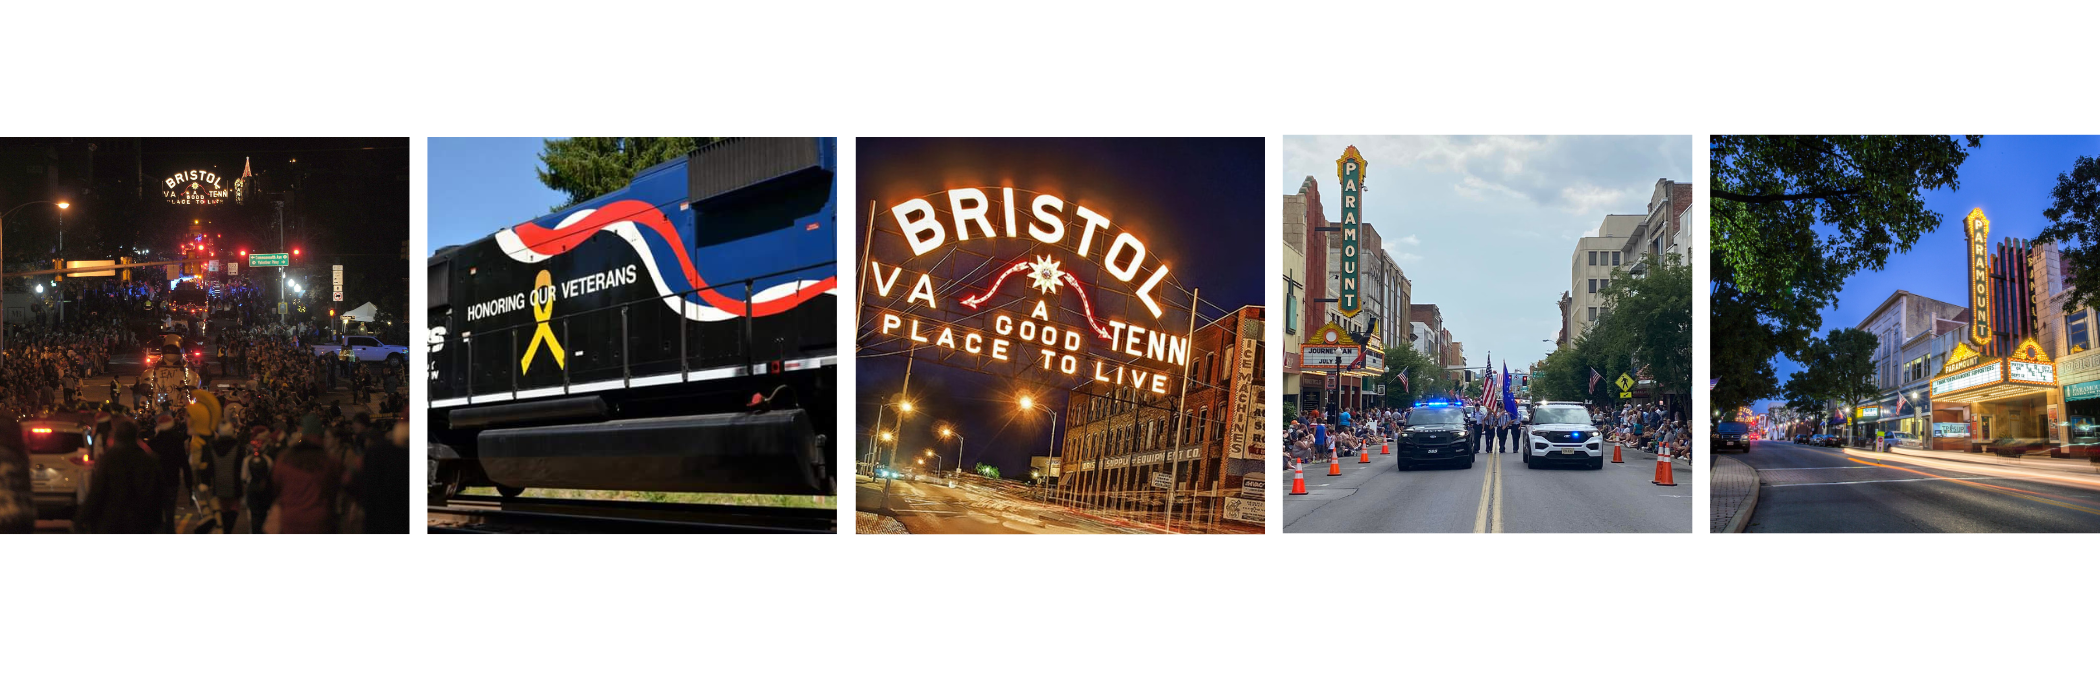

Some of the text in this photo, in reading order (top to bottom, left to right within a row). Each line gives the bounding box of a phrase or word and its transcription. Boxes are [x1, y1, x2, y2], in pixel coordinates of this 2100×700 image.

[165, 170, 221, 189] BRISTOL
[209, 190, 228, 198] TENN
[891, 187, 1169, 319] BRISTOL
[1344, 162, 1357, 307] PARAMOUNT
[467, 264, 637, 321] HONORING OUR VETERANS
[871, 261, 937, 309] VA
[1975, 219, 1986, 336] PARAMOUNT
[995, 315, 1080, 351] GOOD
[1031, 300, 1049, 321] A
[882, 313, 1167, 394] PLACE TO LIVE
[1109, 320, 1187, 366] TENN
[1945, 356, 1978, 374] PARAMOUNT
[1231, 340, 1253, 454] ICE MACHINES
[1137, 450, 1183, 465] EQUIPMET
